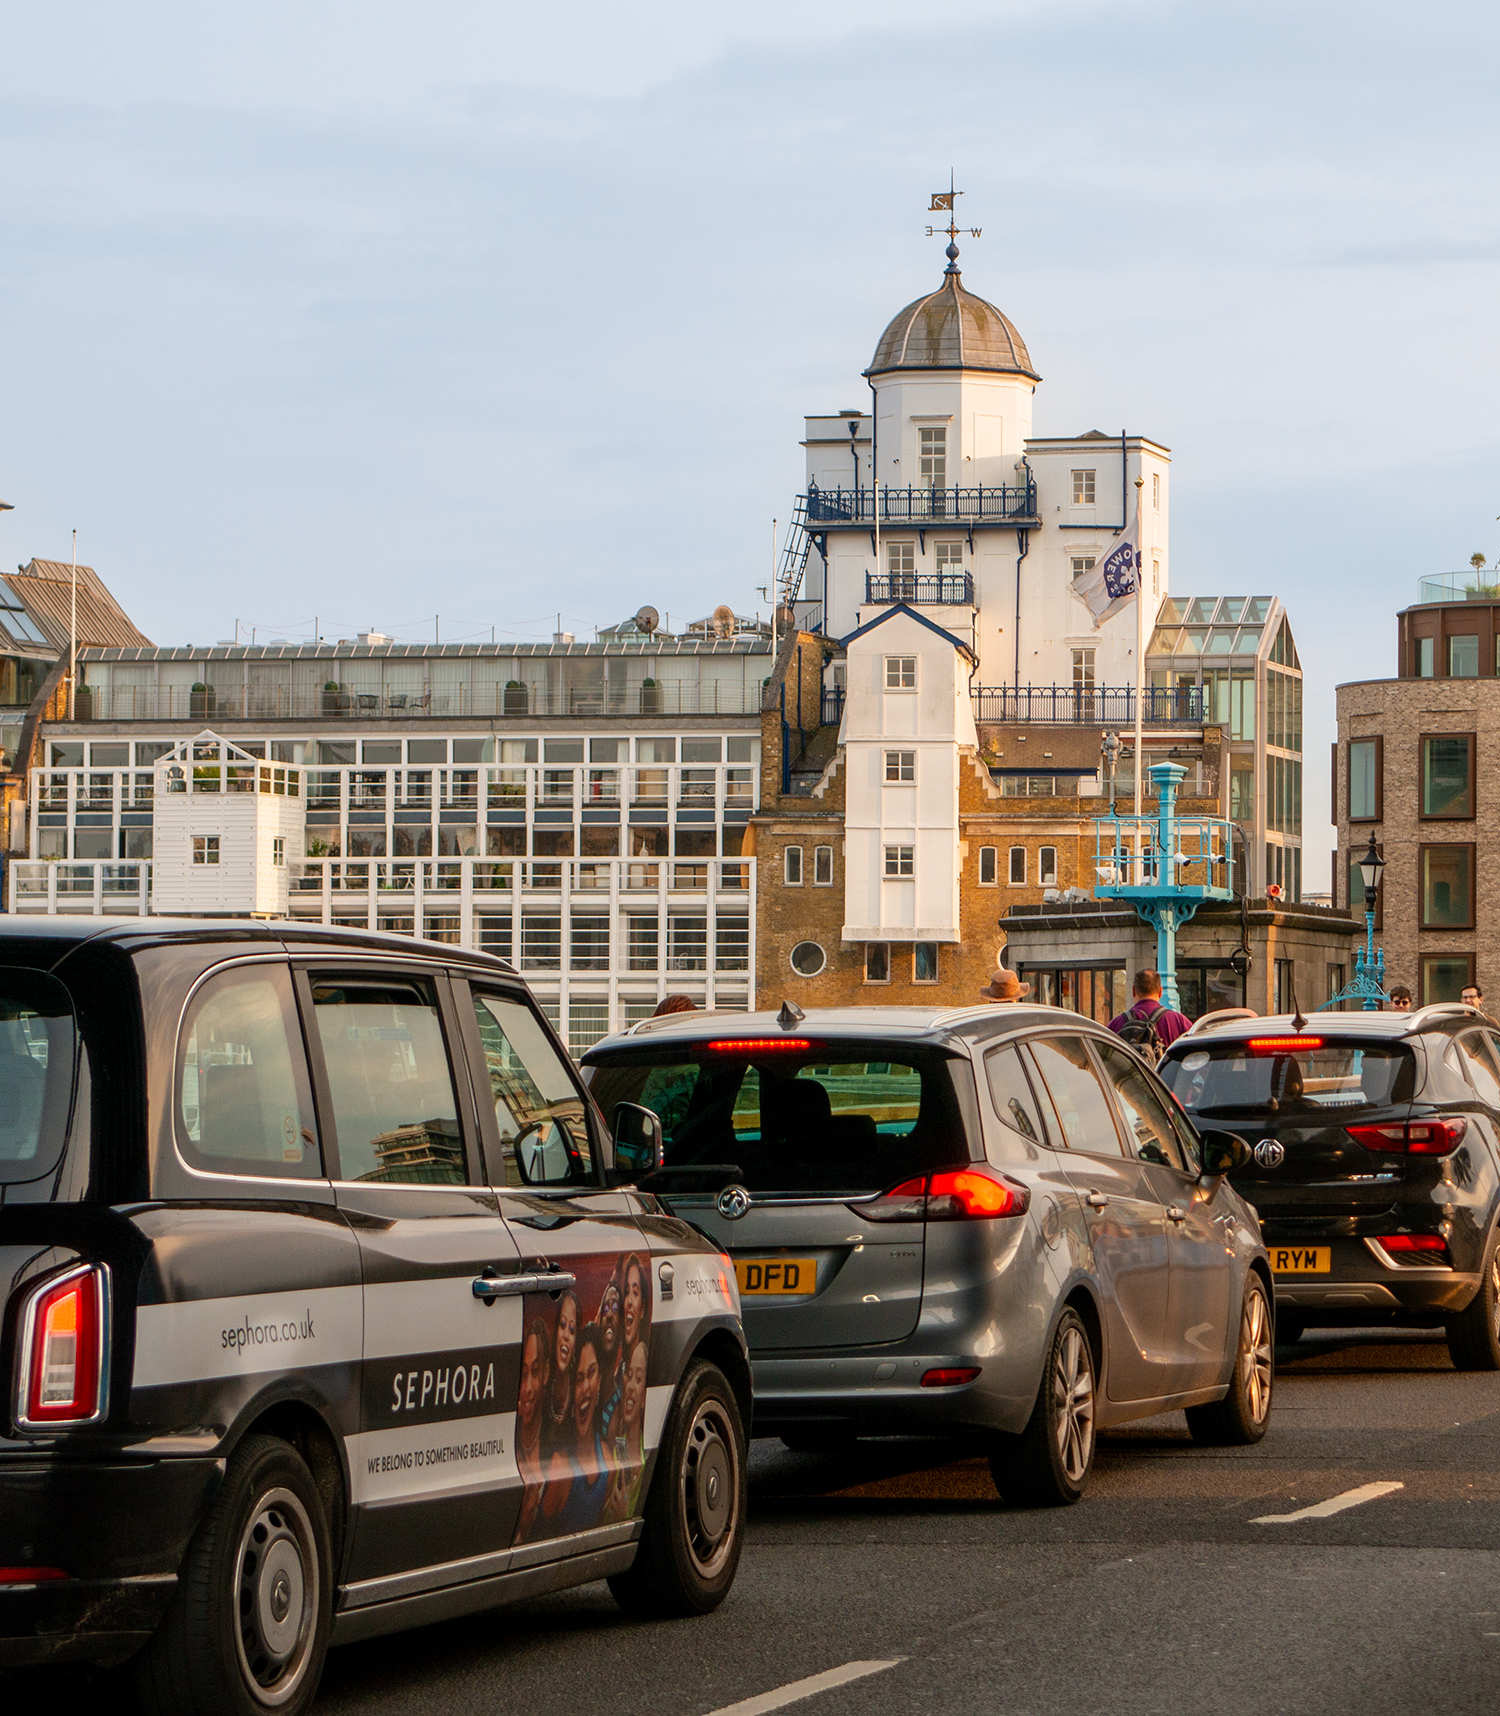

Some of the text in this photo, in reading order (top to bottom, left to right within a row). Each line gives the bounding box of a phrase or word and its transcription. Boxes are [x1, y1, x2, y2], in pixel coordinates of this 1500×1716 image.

[1256, 1142, 1282, 1167] MG
[1277, 1251, 1317, 1269] RYM
[745, 1264, 799, 1290] DFD
[221, 1308, 315, 1355] sephora.co.uk
[391, 1362, 495, 1412] SEPHORA
[367, 1438, 505, 1474] WE BELONG TO SOMETHING BEAUTIFUL
